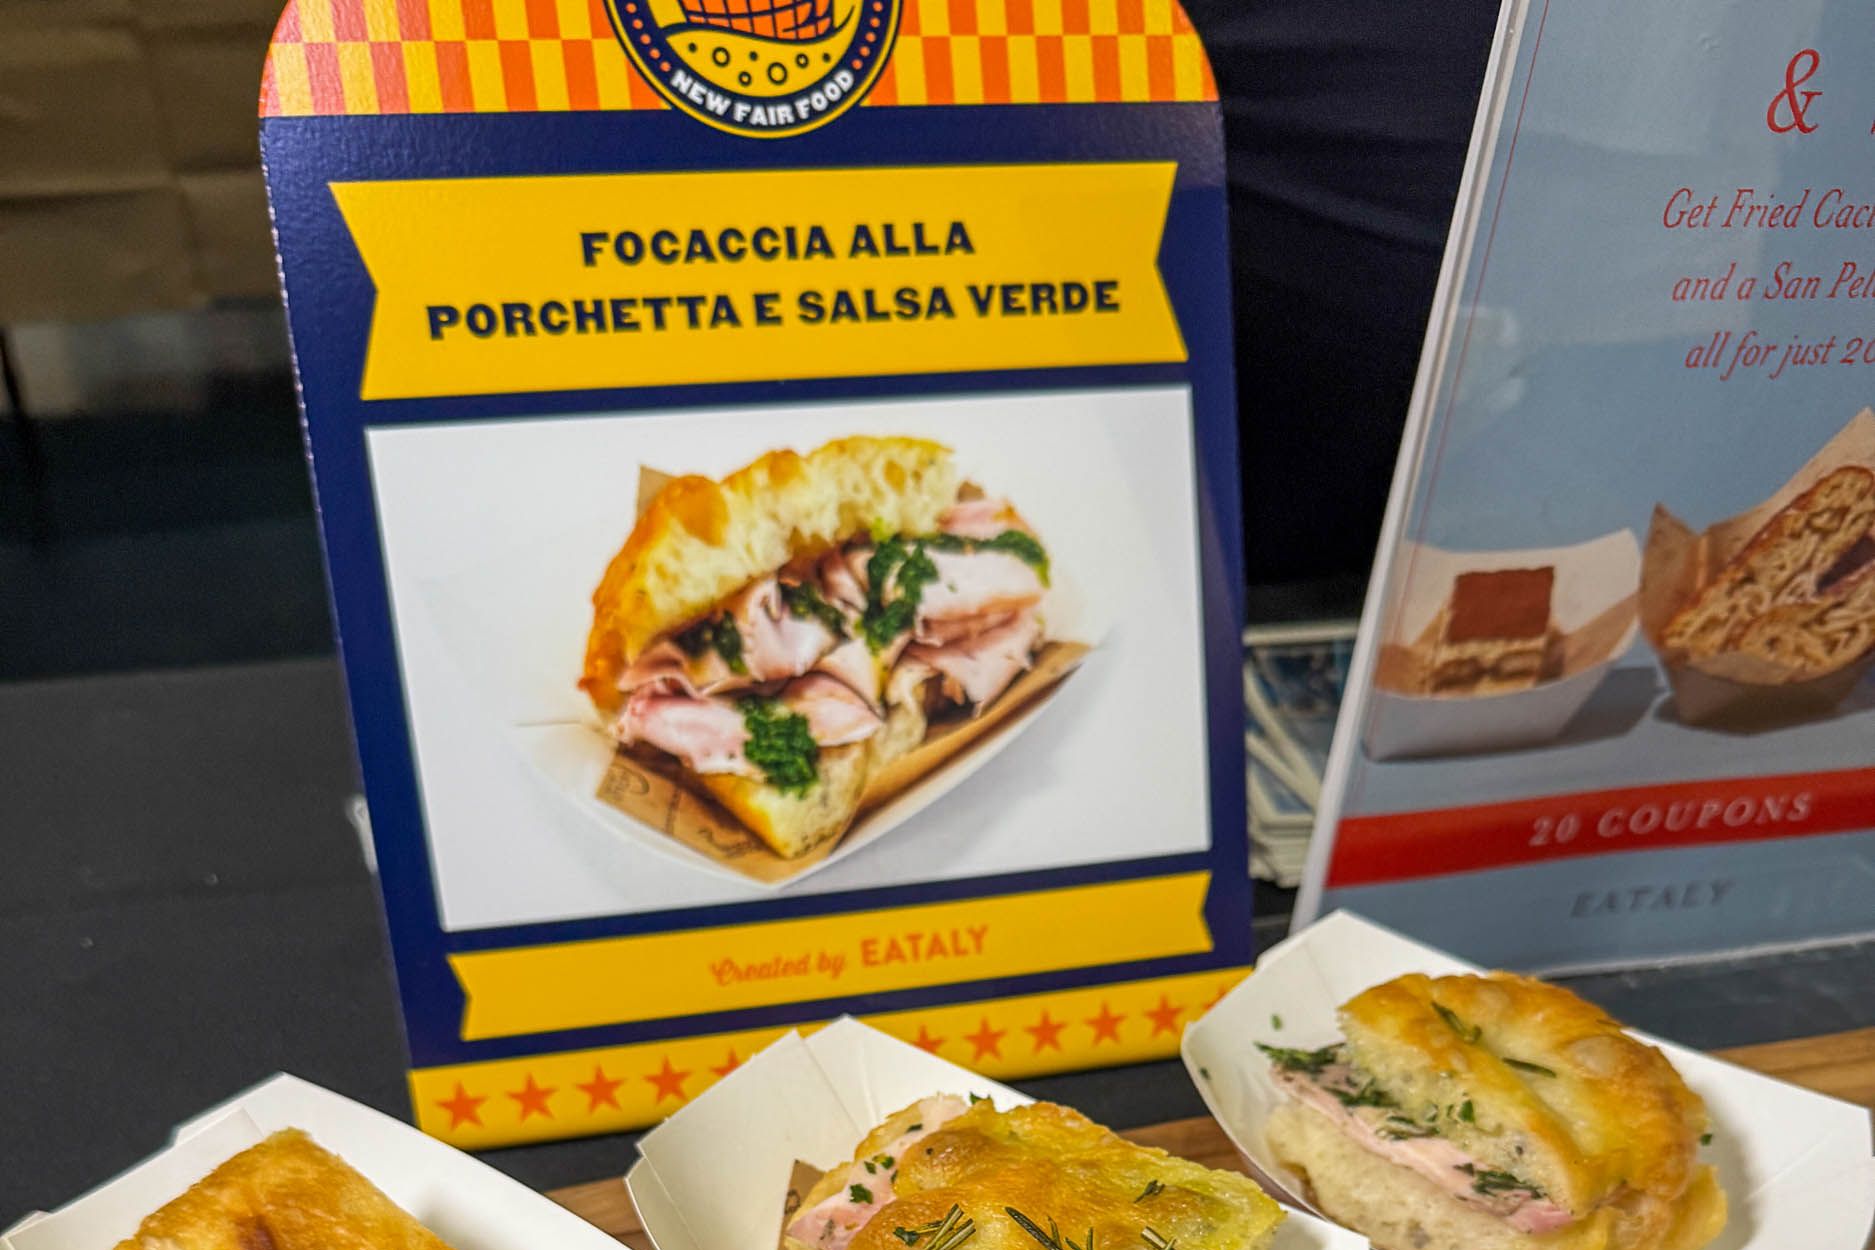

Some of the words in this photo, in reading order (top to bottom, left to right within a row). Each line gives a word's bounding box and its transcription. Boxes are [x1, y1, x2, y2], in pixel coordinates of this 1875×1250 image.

[671, 69, 731, 116] NEW
[733, 102, 795, 126] FAIR
[795, 69, 854, 120] FOOD
[1766, 48, 1823, 134] &
[1663, 188, 1719, 229] Get
[1721, 188, 1810, 229] Fried
[579, 225, 836, 267] FOCACCIA
[848, 221, 975, 258] ALLA
[1672, 262, 1737, 301] and
[1737, 277, 1757, 301] a
[1764, 261, 1822, 300] San
[1827, 261, 1875, 299] Pel
[426, 294, 743, 341] PORCHETTA
[753, 292, 784, 327] E
[798, 286, 956, 325] SALSA
[966, 281, 1120, 318] VERDE
[1685, 330, 1731, 369] all
[1719, 330, 1777, 382] for
[1768, 335, 1837, 381] just
[1528, 813, 1581, 847] 20
[1597, 791, 1814, 838] COUPONS
[1570, 879, 1736, 919] EATALY
[709, 953, 812, 986] Created
[817, 950, 848, 979] by
[860, 924, 990, 968] EATALY
